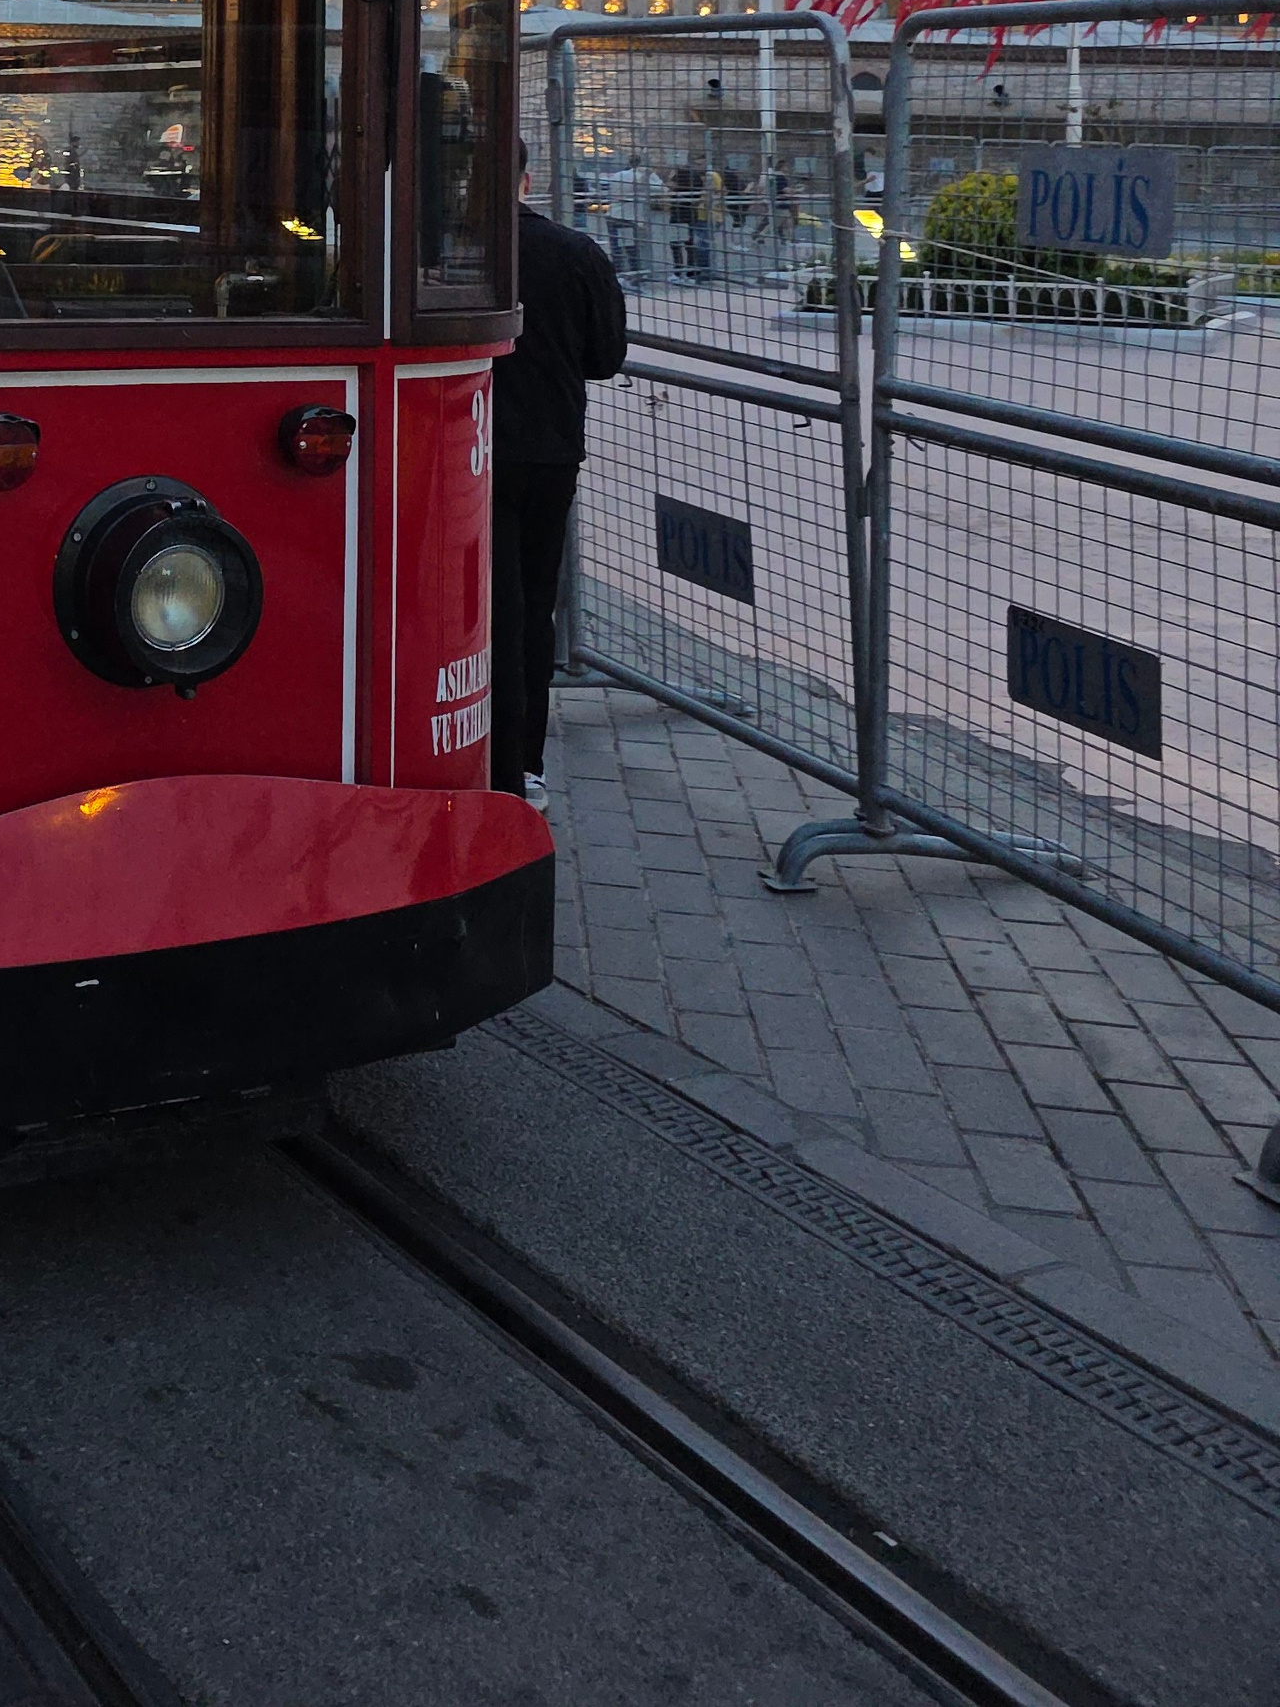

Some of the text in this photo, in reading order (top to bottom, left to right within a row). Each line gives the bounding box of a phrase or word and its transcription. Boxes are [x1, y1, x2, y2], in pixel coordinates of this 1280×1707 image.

[1027, 158, 1152, 251] POLİS
[659, 510, 751, 591] POLİS
[1017, 628, 1141, 735] POLİS
[431, 712, 452, 757] VE
